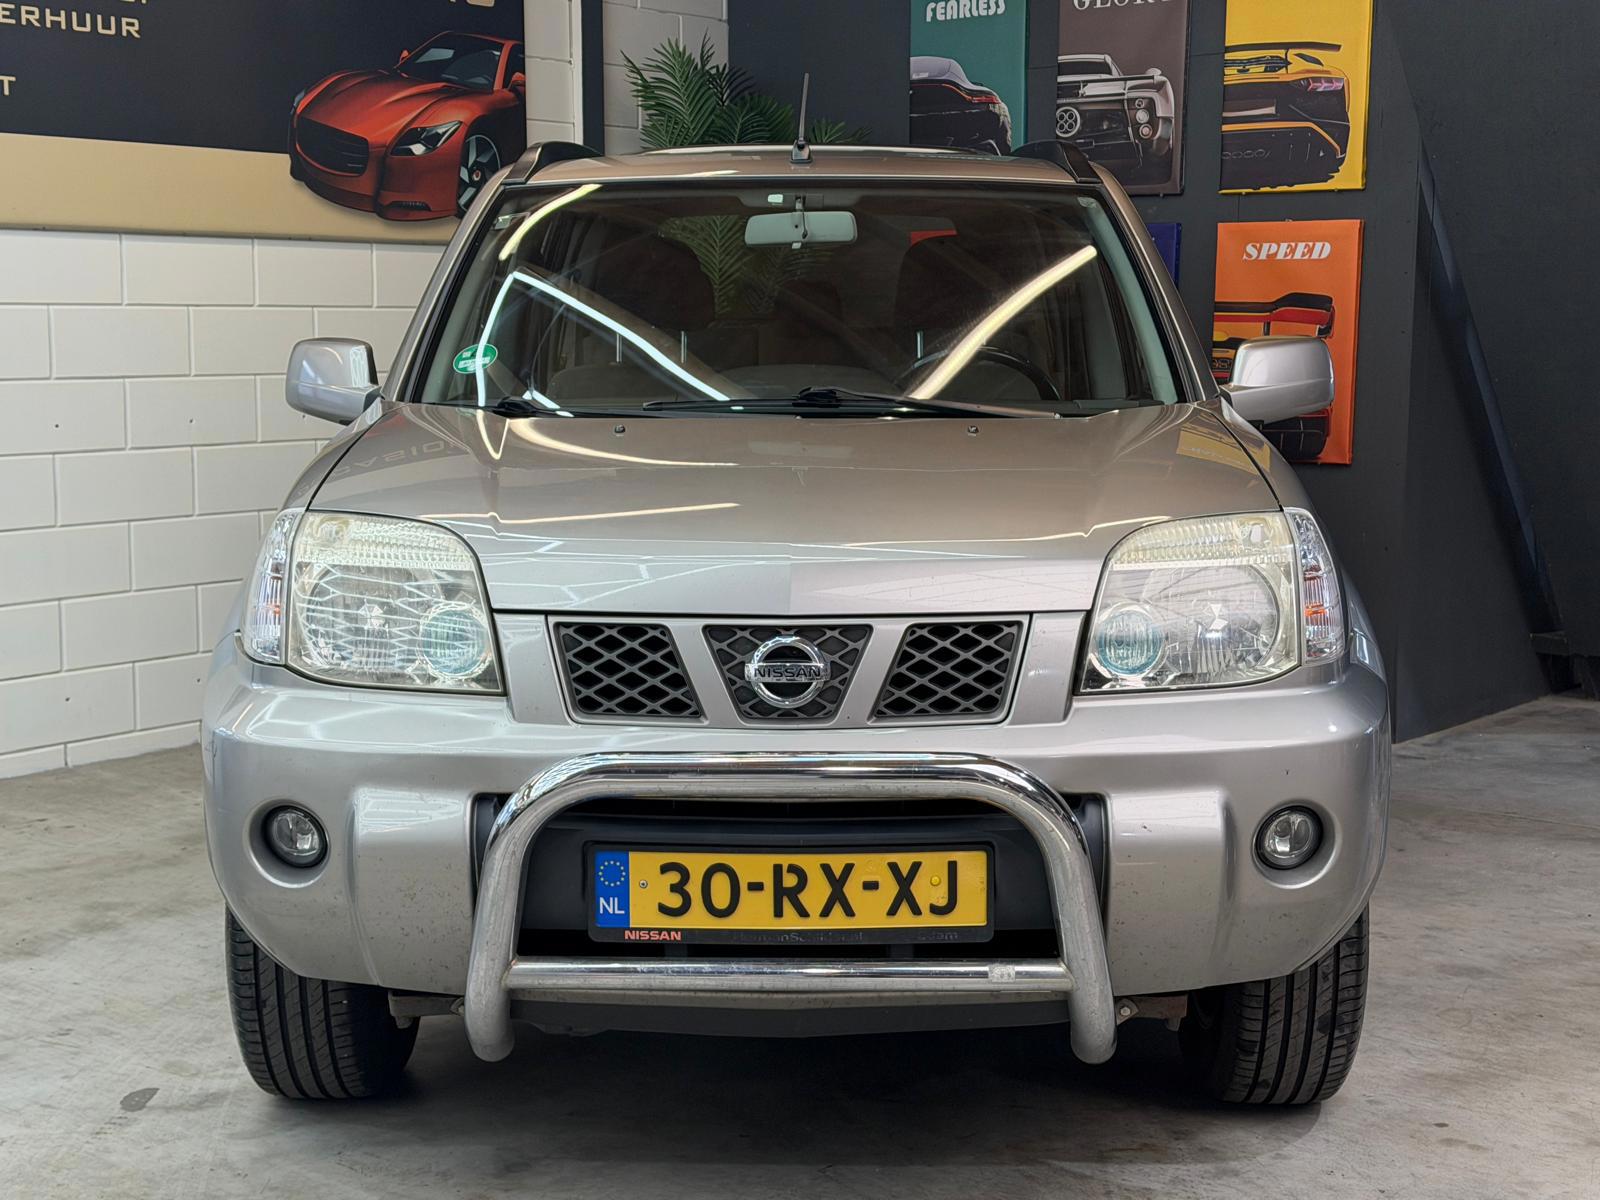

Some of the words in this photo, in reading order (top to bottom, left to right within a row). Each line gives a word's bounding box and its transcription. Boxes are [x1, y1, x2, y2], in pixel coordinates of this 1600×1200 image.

[926, 0, 1006, 22] FEARLESS
[1242, 241, 1332, 261] SPEED
[753, 666, 821, 679] NISSAN
[657, 859, 959, 919] 30-RX-XJ
[599, 896, 626, 915] NL
[624, 929, 682, 941] NISSAN
